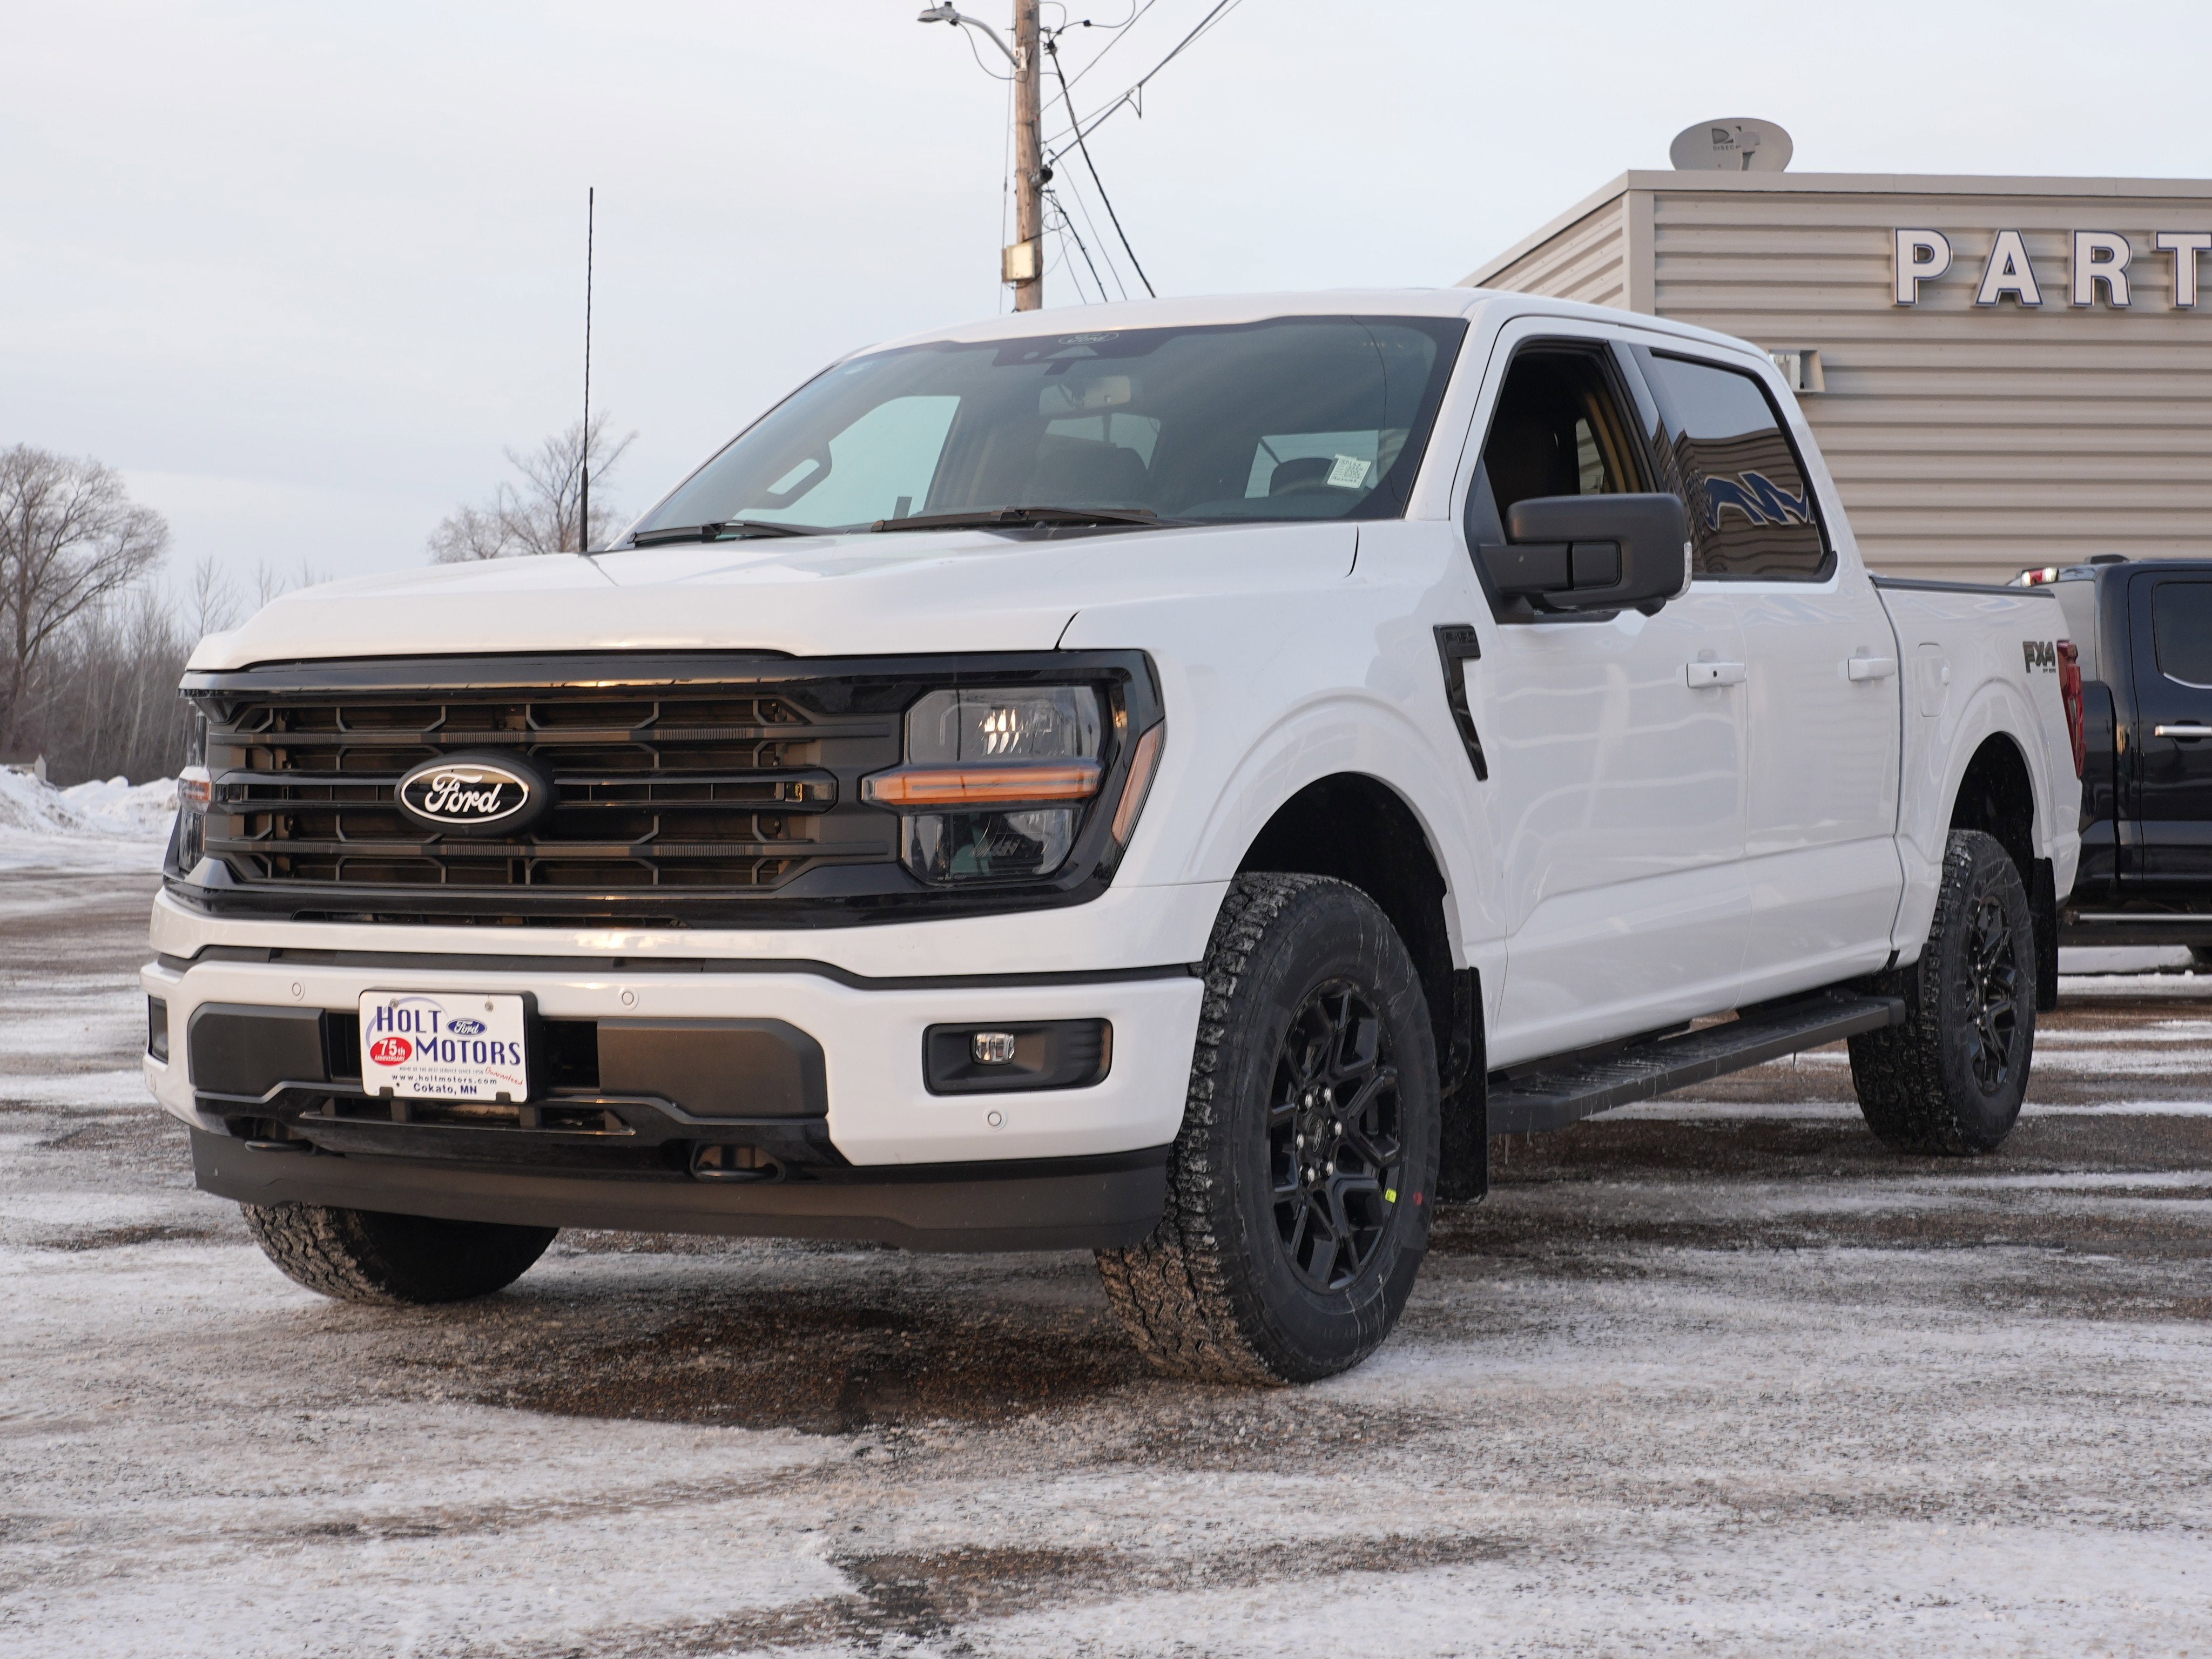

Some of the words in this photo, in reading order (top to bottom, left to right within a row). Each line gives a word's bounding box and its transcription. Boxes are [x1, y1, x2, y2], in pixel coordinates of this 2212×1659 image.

[1892, 228, 2212, 308] PART
[2022, 641, 2055, 673] FX4
[424, 773, 503, 813] Ford
[376, 1006, 442, 1034] HOLT
[454, 1020, 480, 1035] Ford
[379, 1039, 406, 1056] 75th
[416, 1036, 521, 1066] MOTORS
[392, 1073, 497, 1085] www.holtmotors.com
[414, 1083, 456, 1096] Cokato,
[461, 1085, 477, 1095] MN
